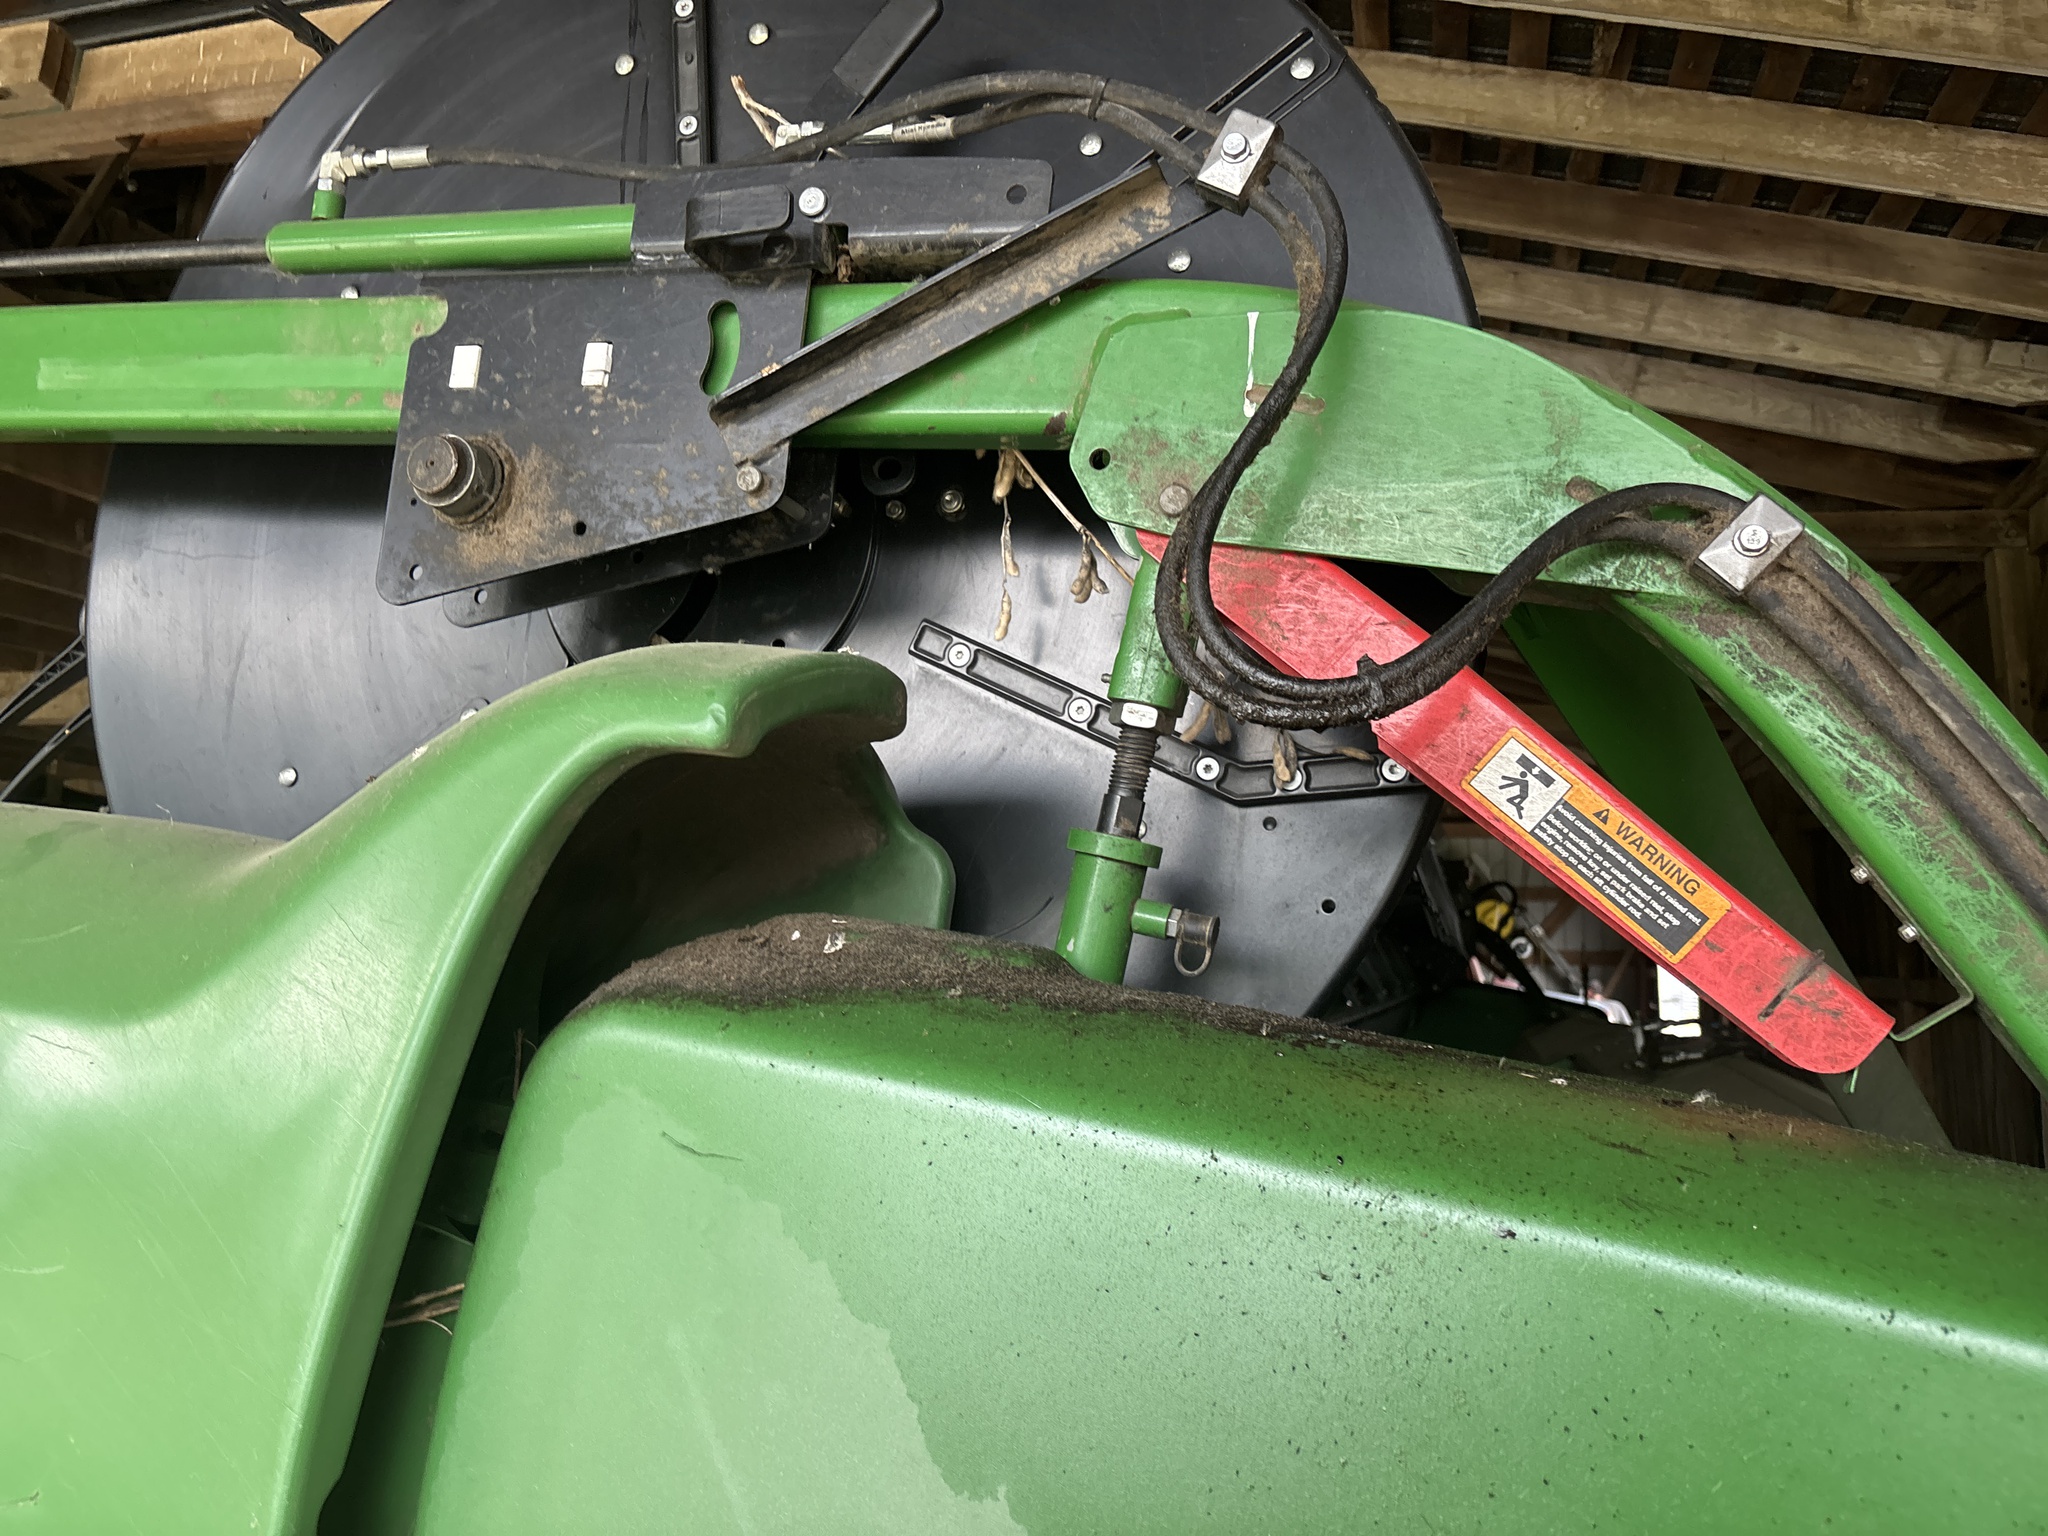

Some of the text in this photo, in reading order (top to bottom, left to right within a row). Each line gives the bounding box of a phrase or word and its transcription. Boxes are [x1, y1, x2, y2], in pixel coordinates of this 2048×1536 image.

[1534, 827, 1556, 846] safety
[1554, 843, 1570, 858] stop
[1568, 856, 1579, 866] on
[1578, 864, 1595, 879] each
[1603, 884, 1631, 908] cylinder
[1628, 905, 1643, 920] rod.
[1541, 821, 1670, 930] engine, remove key, set park brake and set
[1547, 813, 1681, 926] Before working on or under raised reel, stop
[1557, 805, 1577, 821] Avoid
[1574, 819, 1604, 846] crushing
[1602, 841, 1628, 865] injuries
[1626, 861, 1643, 878] from
[1642, 874, 1655, 886] fall
[1652, 884, 1663, 893] of
[1665, 894, 1689, 914] raised
[1686, 911, 1702, 927] reel.
[1616, 820, 1701, 897] WARNING
